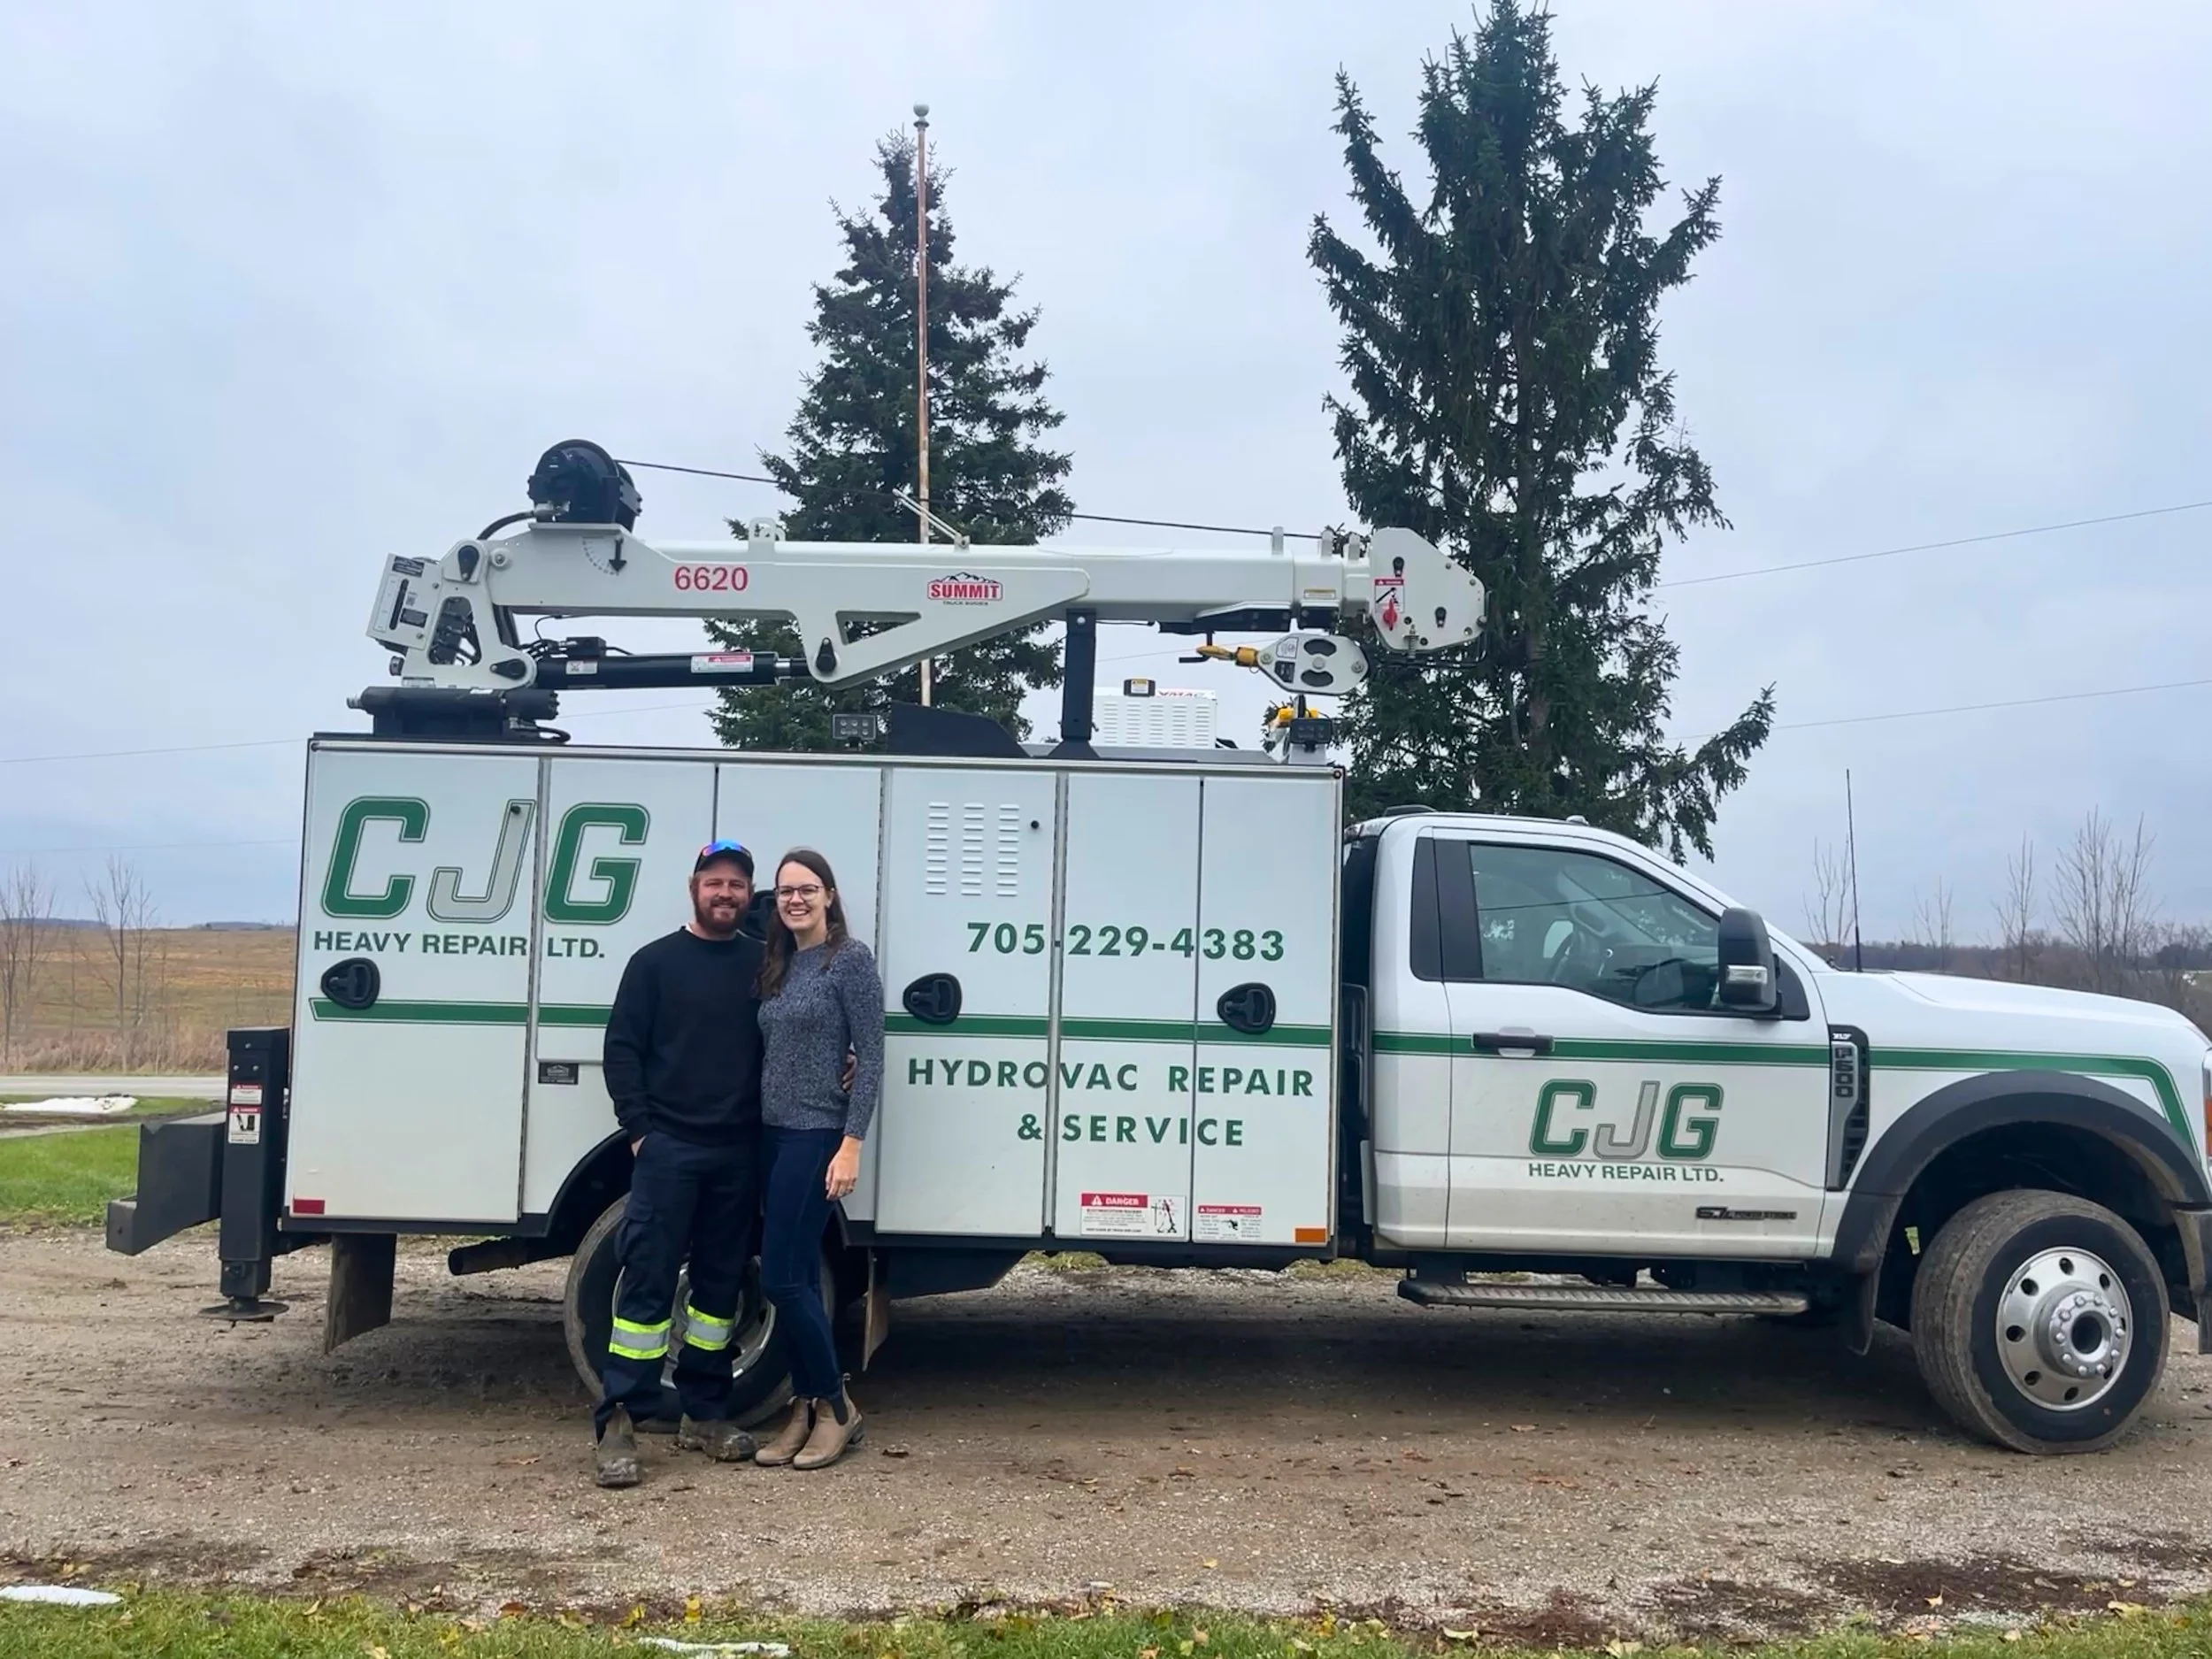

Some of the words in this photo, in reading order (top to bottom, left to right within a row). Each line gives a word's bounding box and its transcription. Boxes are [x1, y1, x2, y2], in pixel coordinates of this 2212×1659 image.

[674, 565, 749, 591] 6620
[931, 583, 999, 599] SUMMIT
[321, 795, 651, 926] CJG
[314, 931, 411, 952] HEAVY
[422, 934, 527, 956] REPAIR
[547, 937, 605, 958] LTD.
[966, 922, 1285, 962] 705-229-4383
[908, 1058, 1138, 1091] HYDROVAC
[1168, 1065, 1314, 1096] REPAIR
[1018, 1113, 1042, 1141] &
[1063, 1114, 1243, 1147] SERVICE
[1529, 1079, 1724, 1161] CJG
[1529, 1163, 1596, 1179] HEAVY
[1602, 1165, 1677, 1181] REPAIR
[1683, 1168, 1724, 1182] LTD.
[1105, 1196, 1140, 1206] DANGER
